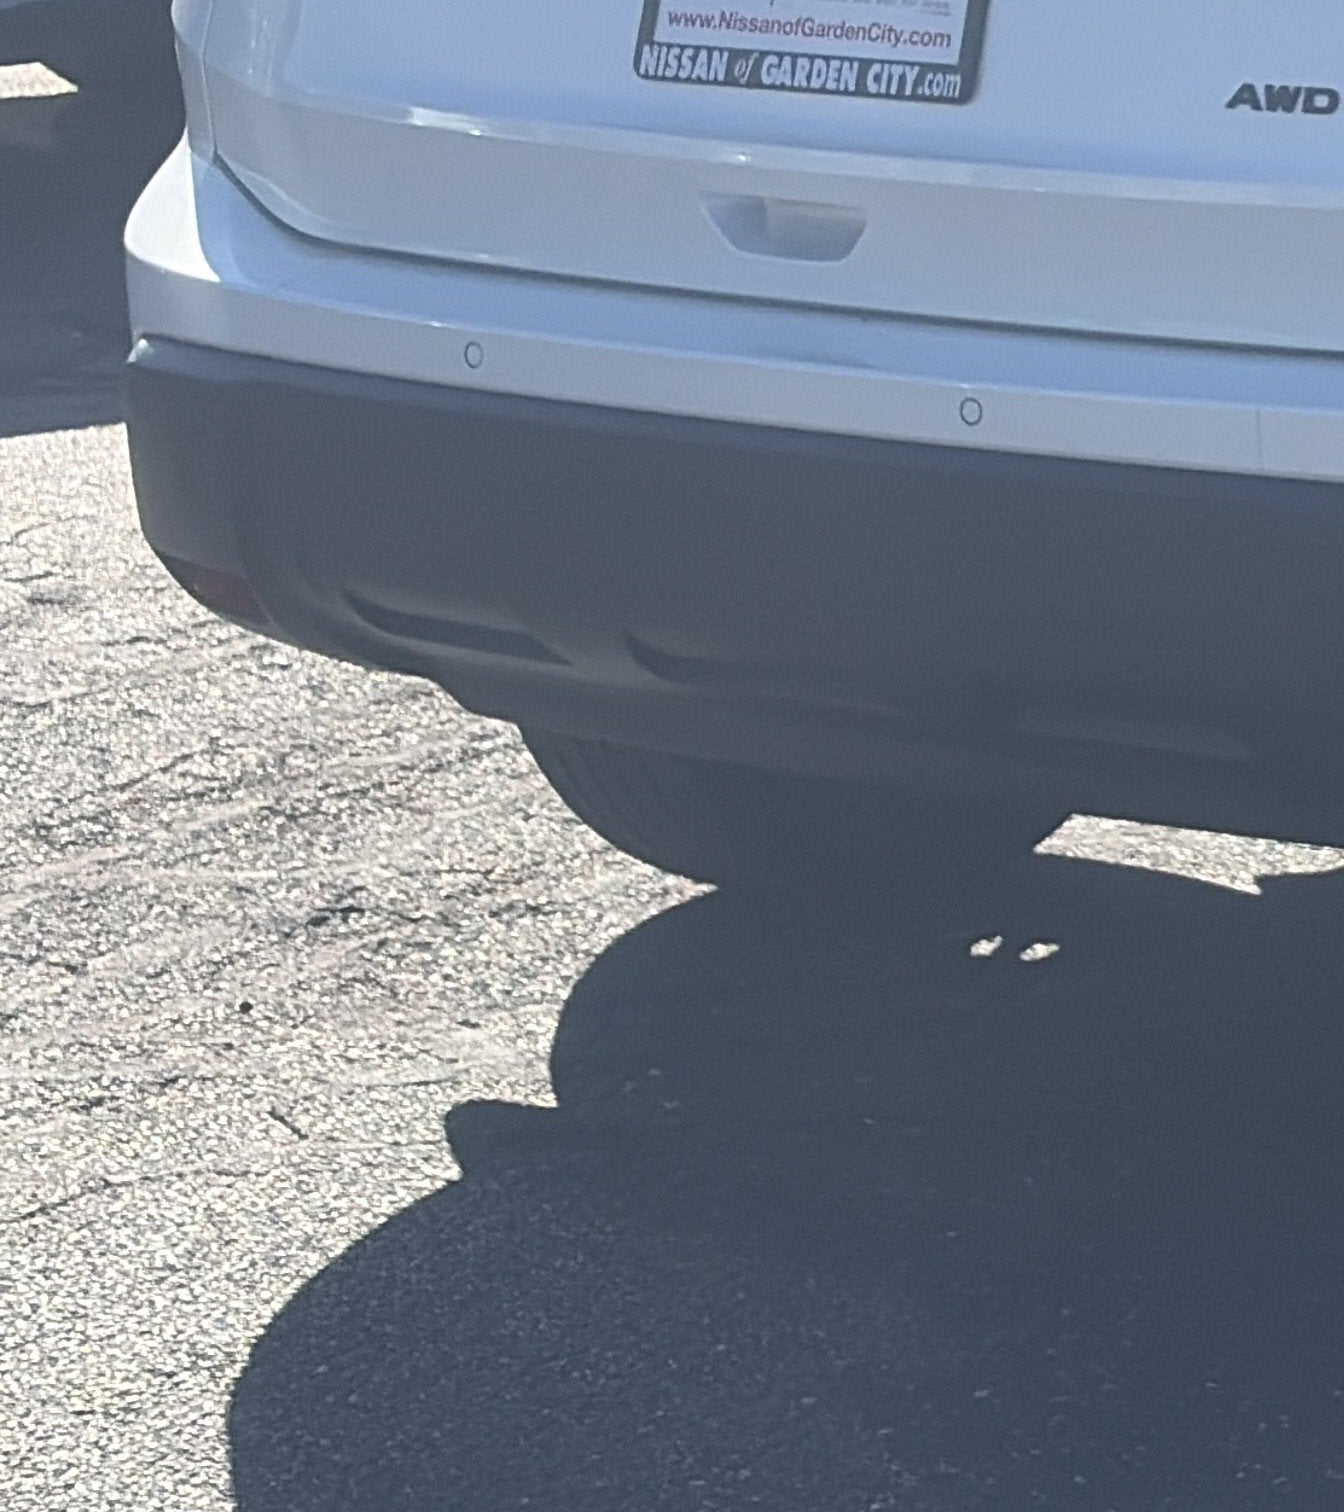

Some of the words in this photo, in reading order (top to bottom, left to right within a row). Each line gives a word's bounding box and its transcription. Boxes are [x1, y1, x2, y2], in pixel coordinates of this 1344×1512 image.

[667, 9, 952, 49] www.NissanofGardenCity.com
[638, 43, 729, 83] NISSAN
[733, 54, 756, 85] of
[760, 54, 859, 93] GARDEN
[866, 64, 962, 99] CITY.com
[1225, 83, 1341, 115] AWD
